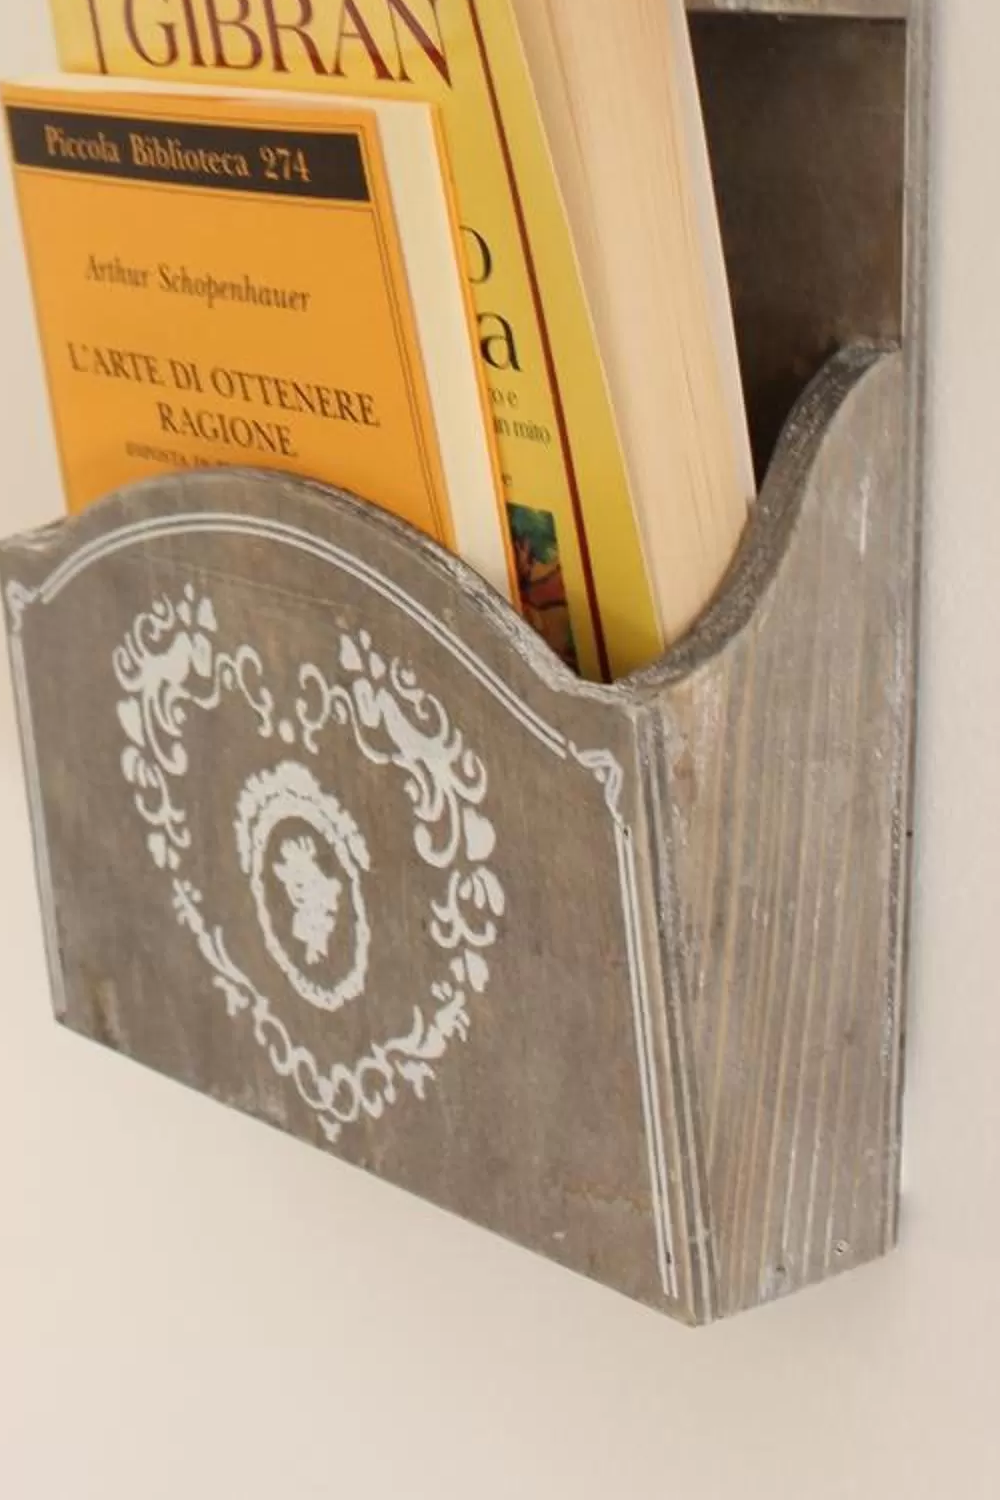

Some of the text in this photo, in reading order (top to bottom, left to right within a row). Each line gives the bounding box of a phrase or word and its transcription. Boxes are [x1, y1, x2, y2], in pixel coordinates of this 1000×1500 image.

[43, 124, 312, 183] Piccola Biblioteca 274
[86, 253, 311, 312] Arthur Schopenhauer
[67, 341, 381, 428] L'ARTE DI OTTENERE
[155, 401, 298, 458] RAGIONE
